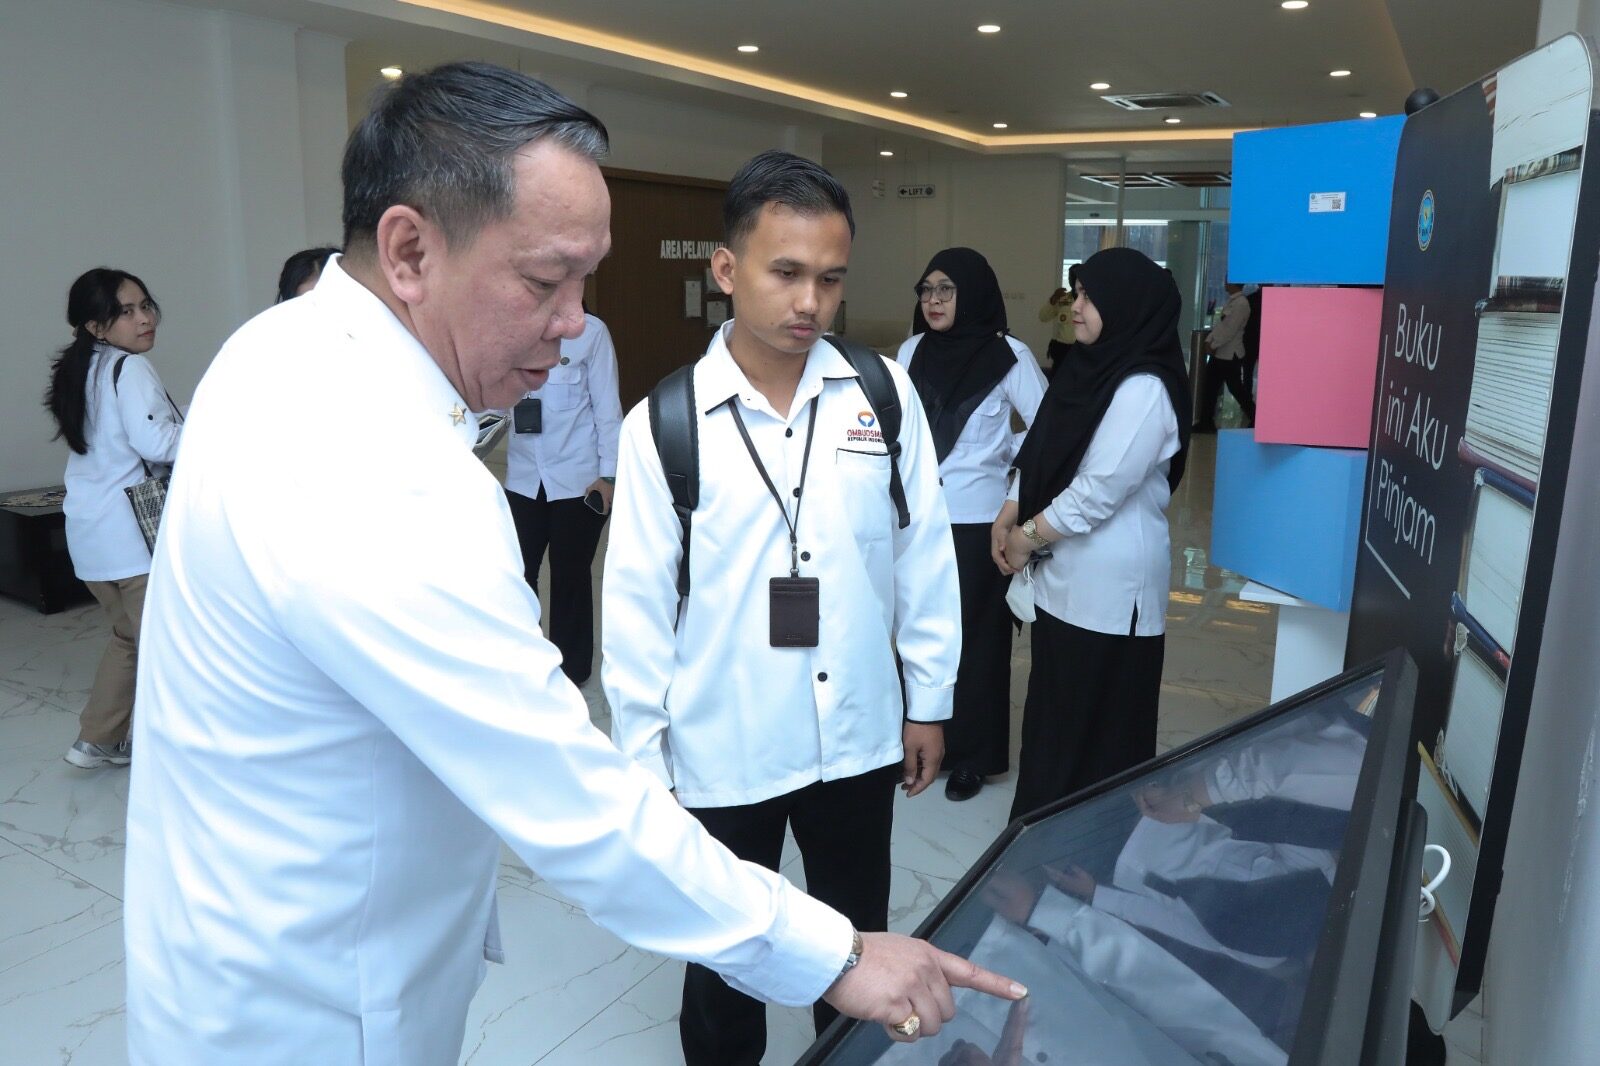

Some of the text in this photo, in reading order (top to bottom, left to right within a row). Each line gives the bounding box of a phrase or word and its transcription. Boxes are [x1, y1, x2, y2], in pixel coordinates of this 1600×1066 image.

[908, 188, 923, 196] LIFT
[660, 240, 725, 259] AREA PELAYAN
[1395, 303, 1442, 371] Buku
[1385, 380, 1449, 471] ini Aku
[1377, 458, 1436, 566] Pinjam
